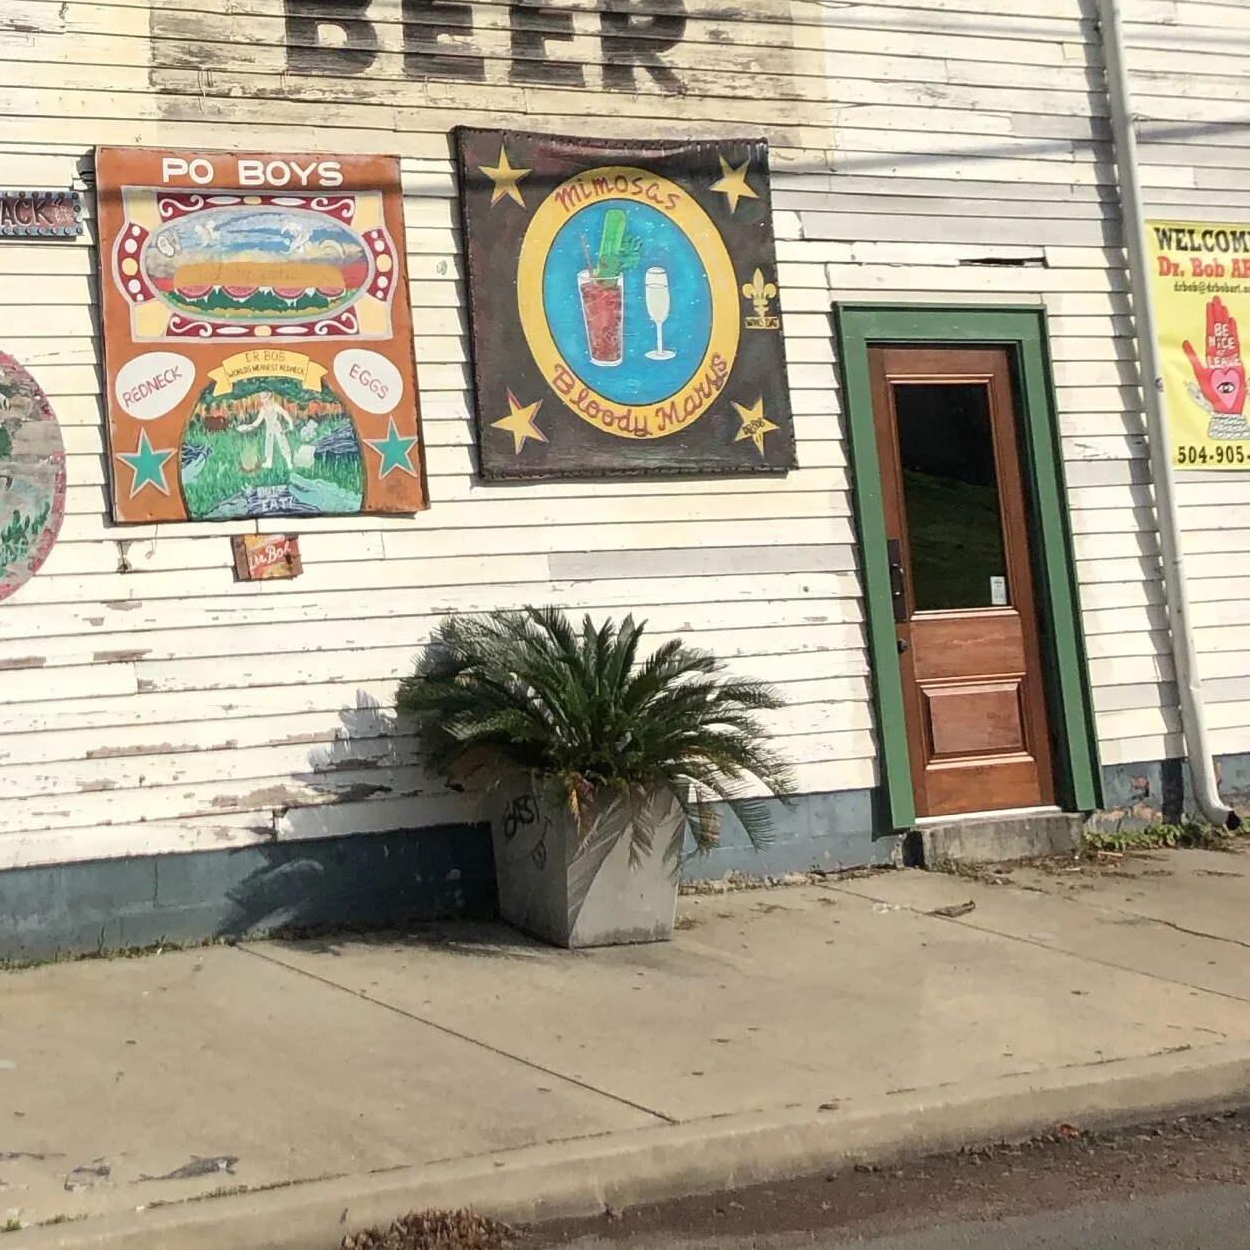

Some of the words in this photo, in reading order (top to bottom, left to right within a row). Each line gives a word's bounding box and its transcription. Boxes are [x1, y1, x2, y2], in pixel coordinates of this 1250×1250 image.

[162, 157, 214, 184] PO
[238, 161, 343, 187] BOYS
[1153, 226, 1250, 253] WELCOM
[1157, 256, 1185, 277] Dr.
[1190, 257, 1225, 278] Bob
[1213, 322, 1229, 337] BE
[122, 365, 183, 408] REDNECK
[348, 362, 390, 400] EGGS
[552, 363, 652, 437] Bloody
